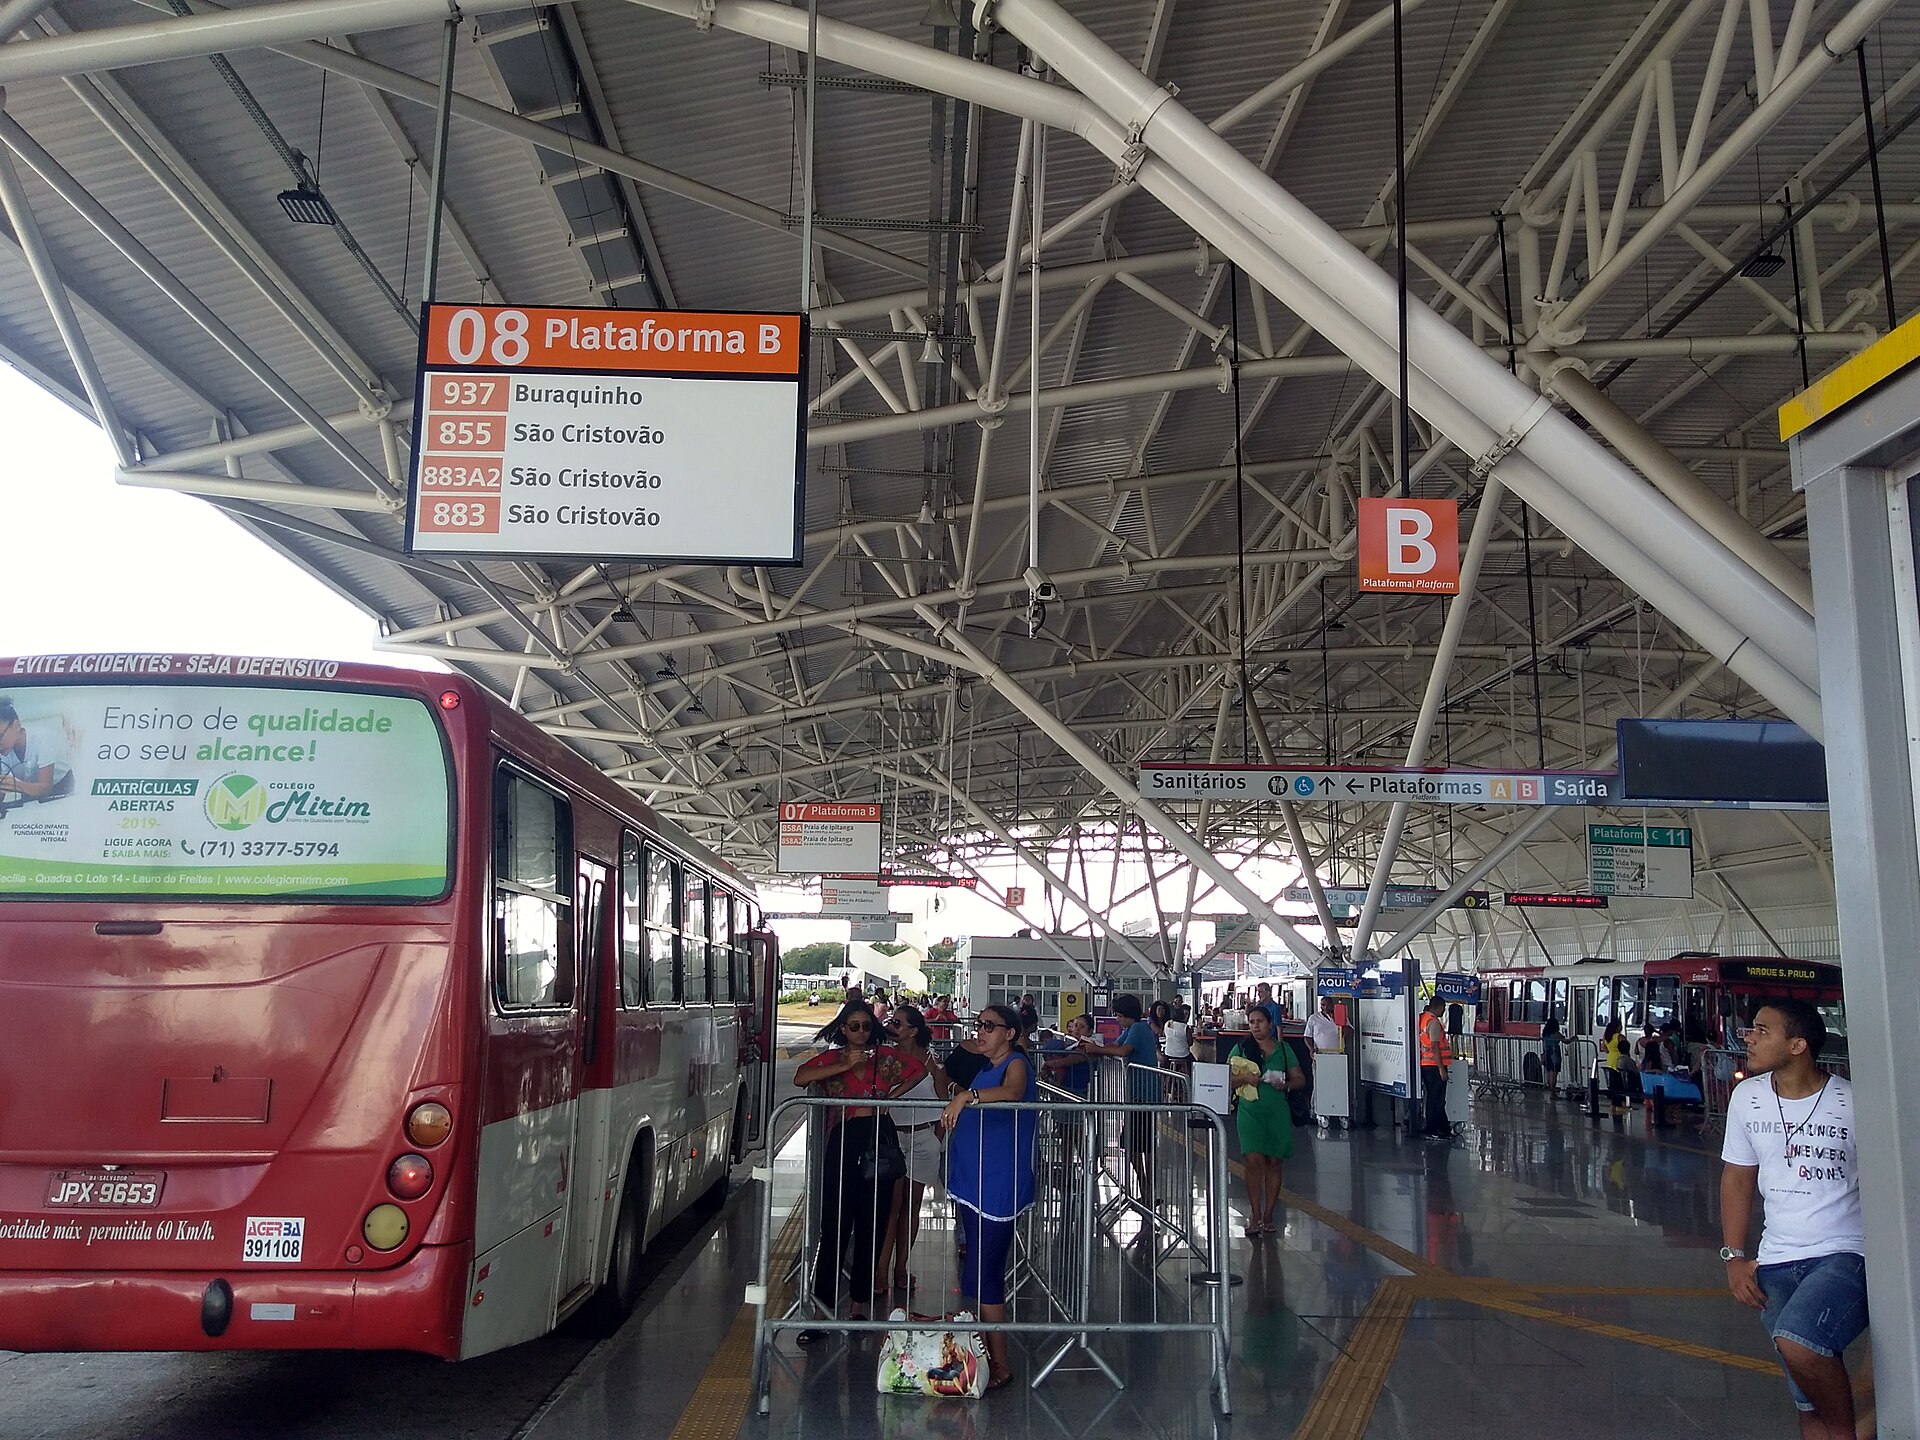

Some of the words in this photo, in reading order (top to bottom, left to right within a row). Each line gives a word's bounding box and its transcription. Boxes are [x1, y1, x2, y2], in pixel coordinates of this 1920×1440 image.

[447, 308, 529, 366] 08
[545, 318, 745, 354] Plataforma
[758, 324, 781, 354] B
[443, 382, 496, 405] 937
[515, 383, 643, 408] Buraquinho
[439, 422, 491, 445] 855
[513, 423, 555, 444] São
[562, 424, 665, 445] Cristovão
[423, 466, 500, 487] 883A2
[510, 467, 551, 488] São
[558, 468, 662, 490] Cristovão
[433, 502, 486, 527] 883
[507, 505, 550, 525] São
[556, 505, 661, 527] Cristovão
[1386, 508, 1437, 574] B
[1416, 580, 1454, 590] Platform
[13, 655, 66, 674] EVITE
[69, 655, 172, 673] ACIDENTES
[186, 656, 232, 674] SEJA
[235, 657, 340, 678] DEFENSIVO
[103, 707, 193, 730] Ensino
[203, 707, 238, 730] de
[248, 708, 393, 737] qualidade
[97, 743, 130, 760] ao
[140, 743, 187, 760] seu
[196, 737, 317, 762] alcance!
[96, 779, 192, 795] MATRÍCULAS
[269, 782, 315, 790] COLÉGIO
[1152, 773, 1247, 790] Sanitários
[1370, 777, 1482, 795] Plataformas
[1495, 783, 1507, 797] A
[1521, 783, 1533, 797] B
[1554, 779, 1608, 797] Saída
[108, 800, 175, 812] ABERTAS
[266, 790, 371, 824] Mirim
[785, 804, 808, 820] 07
[811, 806, 866, 816] Plataforma
[869, 806, 876, 816] B
[782, 824, 802, 832] 858A
[104, 838, 133, 847] LIGUE
[135, 838, 172, 847] AGORA
[1651, 830, 1659, 840] C
[1666, 829, 1685, 846] 11
[103, 850, 109, 858] E
[111, 850, 140, 858] SAIBA
[144, 850, 171, 858] MAIS:
[200, 841, 235, 858] (71)
[241, 841, 339, 857] 3377-5794
[35, 874, 72, 883] Quadra
[75, 874, 83, 883] C
[87, 874, 108, 883] Lote
[111, 874, 123, 883] 14
[133, 874, 161, 883] Lauro
[164, 874, 176, 883] de
[179, 874, 213, 884] Freitas
[225, 874, 349, 886] www.colegiomirim.com
[1011, 888, 1022, 904] B
[1394, 892, 1422, 903] Saída
[1787, 967, 1815, 978] PAULO
[1318, 978, 1345, 987] AQUI
[1436, 983, 1463, 994] AQUI
[53, 1219, 82, 1240] máx
[87, 1219, 153, 1246] permitida
[156, 1223, 173, 1240] 60
[175, 1220, 215, 1241] Km/h.
[246, 1220, 301, 1237] AGERBA
[245, 1239, 300, 1258] 391108
